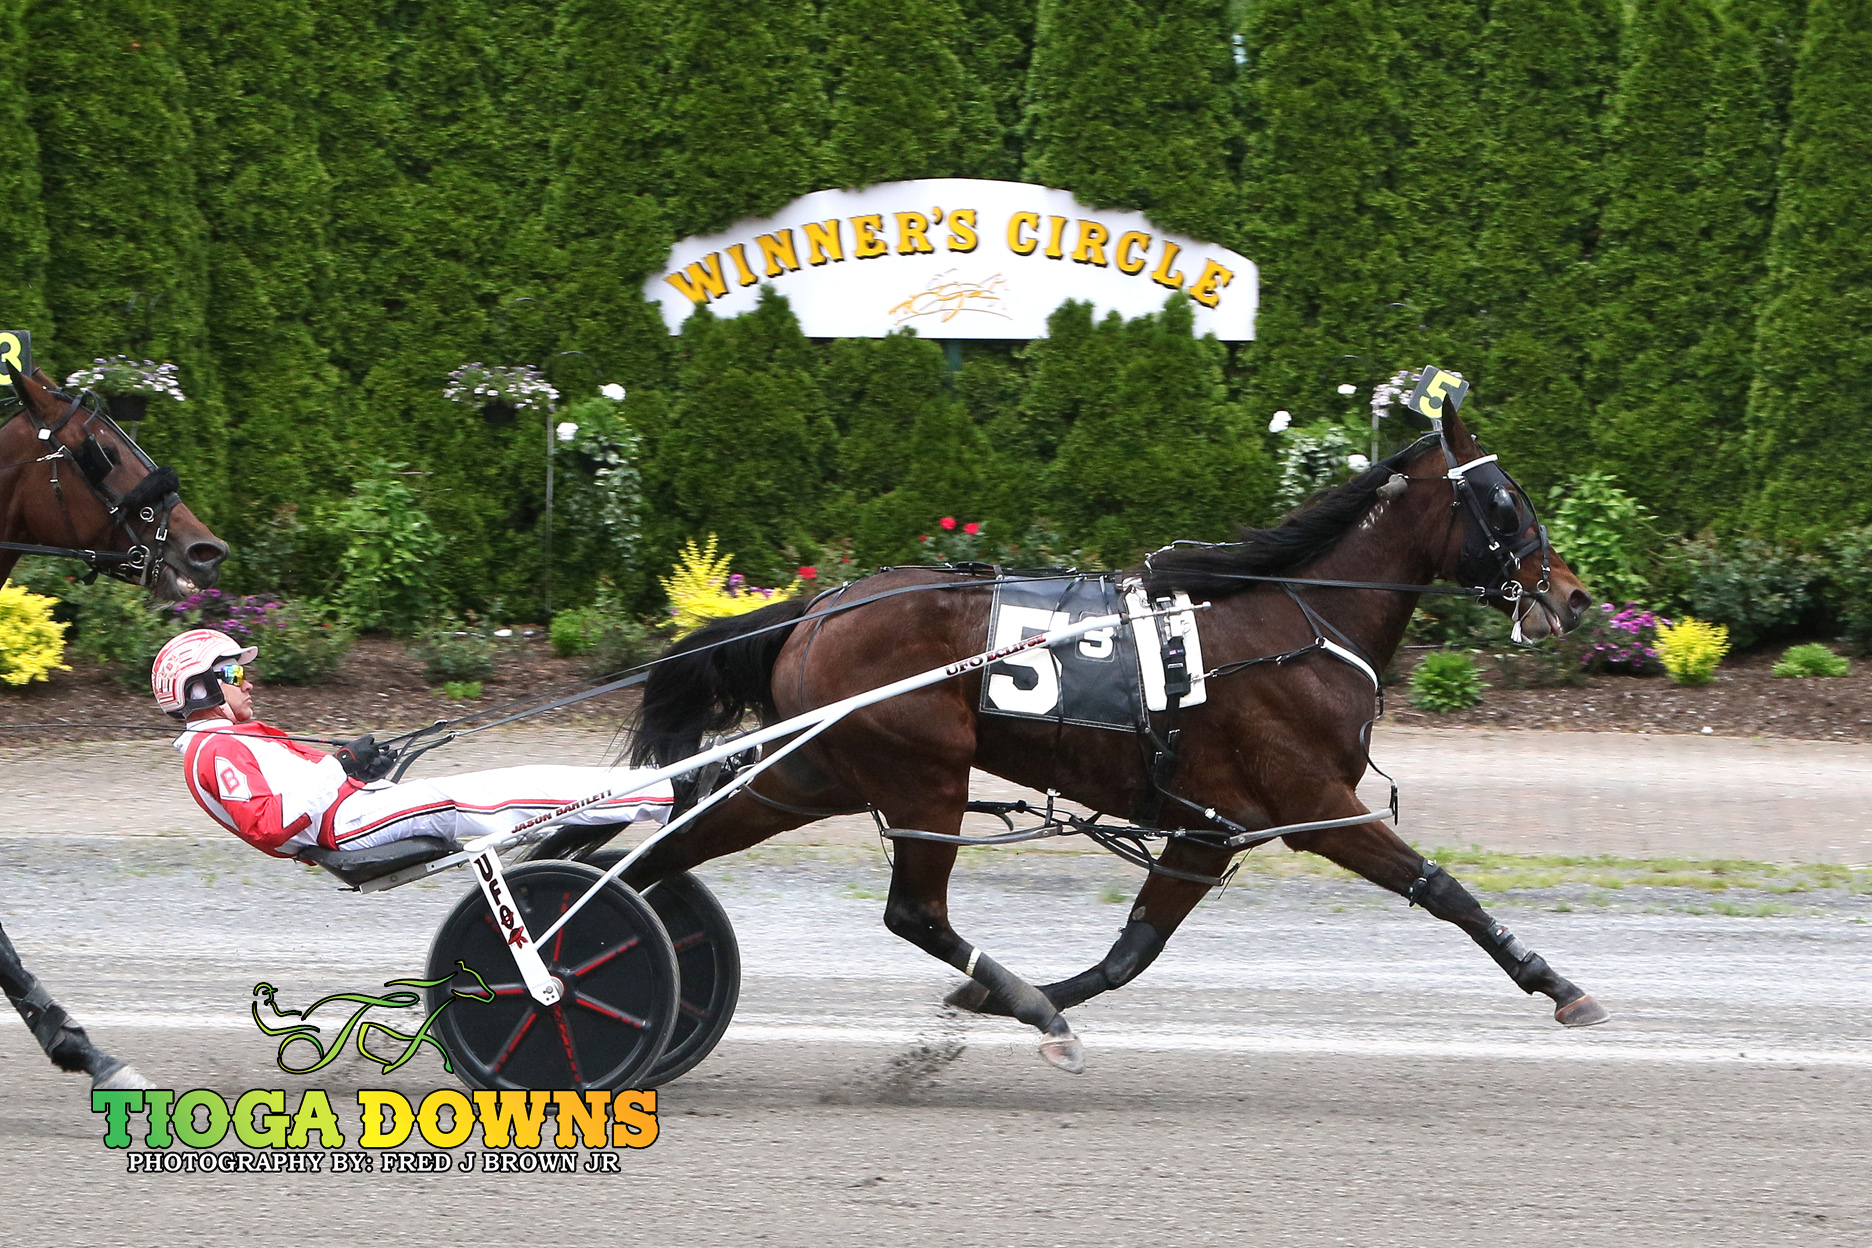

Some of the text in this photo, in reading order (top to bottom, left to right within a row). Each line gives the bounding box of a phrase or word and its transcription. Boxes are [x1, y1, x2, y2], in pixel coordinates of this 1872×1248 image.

[664, 206, 1235, 309] WINNER'S CIRCLE
[1419, 370, 1462, 419] 5
[945, 634, 1047, 676] UFO ECLIPSE
[988, 604, 1070, 715] 5
[221, 766, 241, 795] B
[511, 789, 613, 834] JASON BARTLETT
